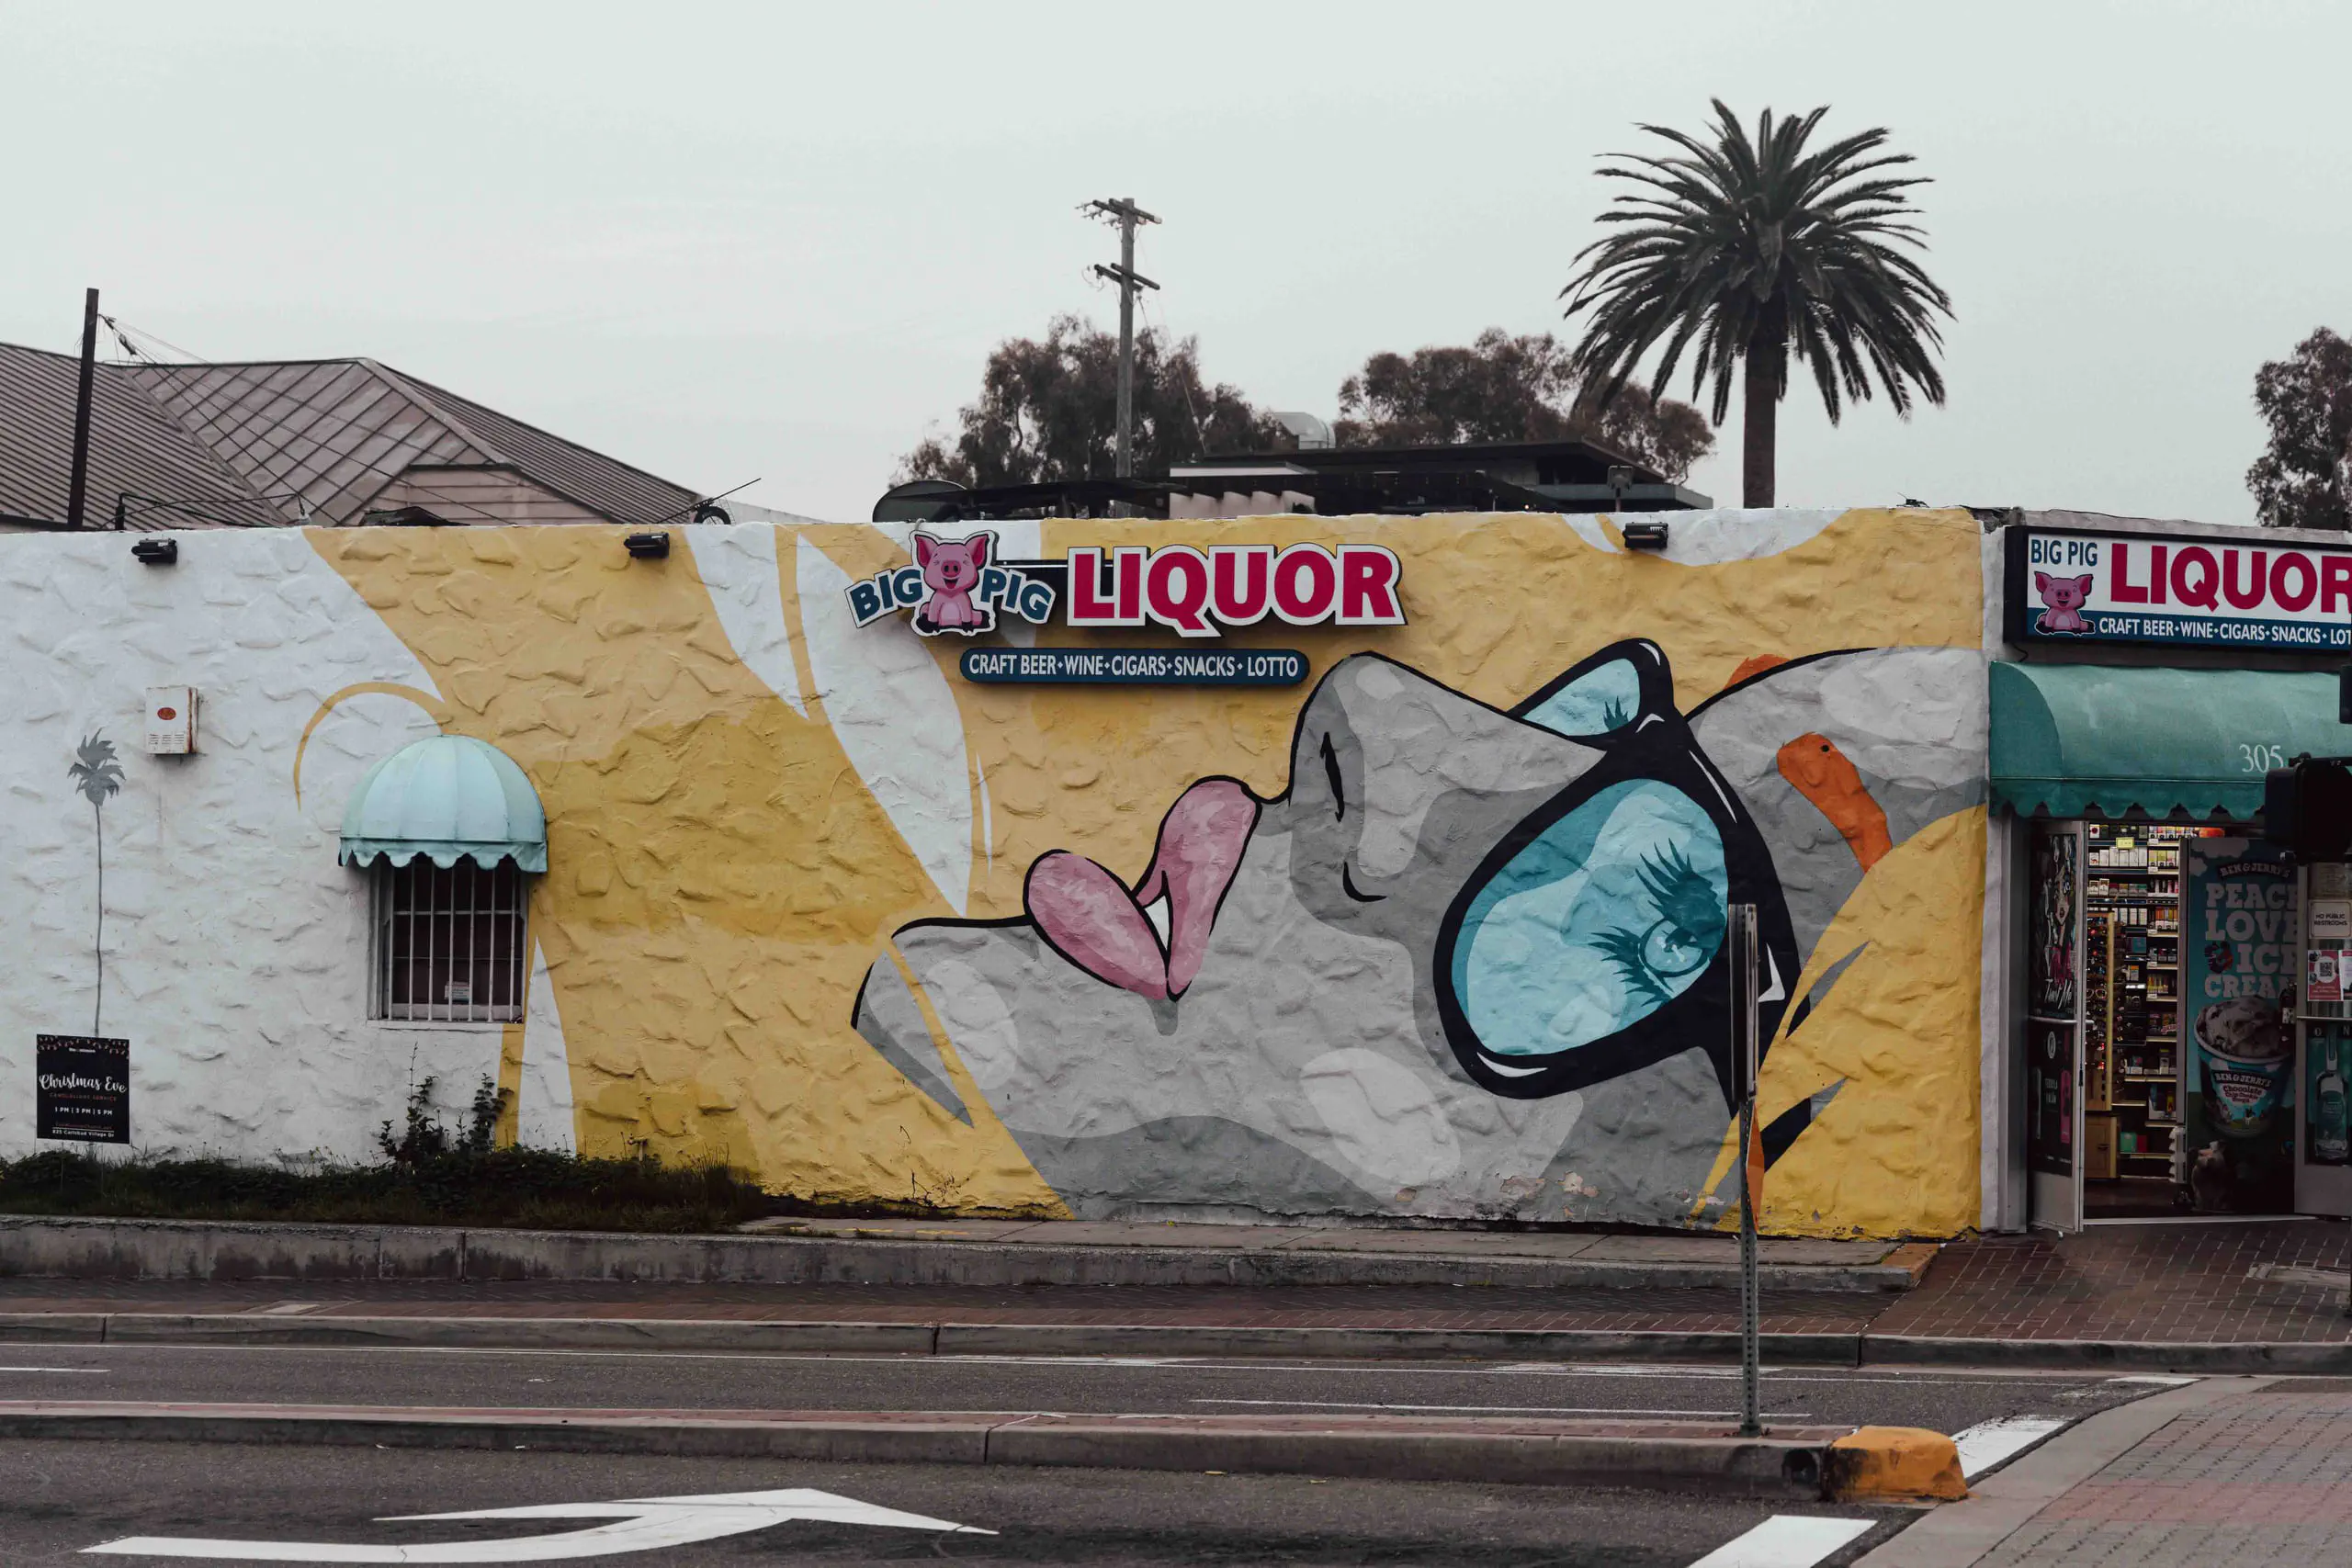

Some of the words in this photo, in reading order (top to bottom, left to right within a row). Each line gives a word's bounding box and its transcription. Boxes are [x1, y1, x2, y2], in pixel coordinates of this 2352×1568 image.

[2030, 539, 2063, 565] BIG
[2067, 541, 2098, 567] PIG
[850, 568, 923, 623] BIG
[980, 568, 1052, 621] PIG
[1072, 548, 1408, 631] LIQUOR
[2098, 616, 2140, 636] CRAFT
[2143, 619, 2175, 637] BEER
[2180, 621, 2213, 638] WINE
[2220, 623, 2266, 641] CIGARS
[2271, 626, 2321, 645] SNACKS
[969, 653, 1017, 675] CRAFT
[1020, 654, 1057, 675] BEER
[1064, 655, 1103, 676] WINE
[1111, 655, 1169, 677] CIGARS
[1174, 656, 1236, 678] SNACKS
[1247, 656, 1299, 678] LOTTO
[2239, 744, 2285, 773] 305
[39, 1072, 103, 1091] Christmas
[105, 1076, 128, 1094] Eve
